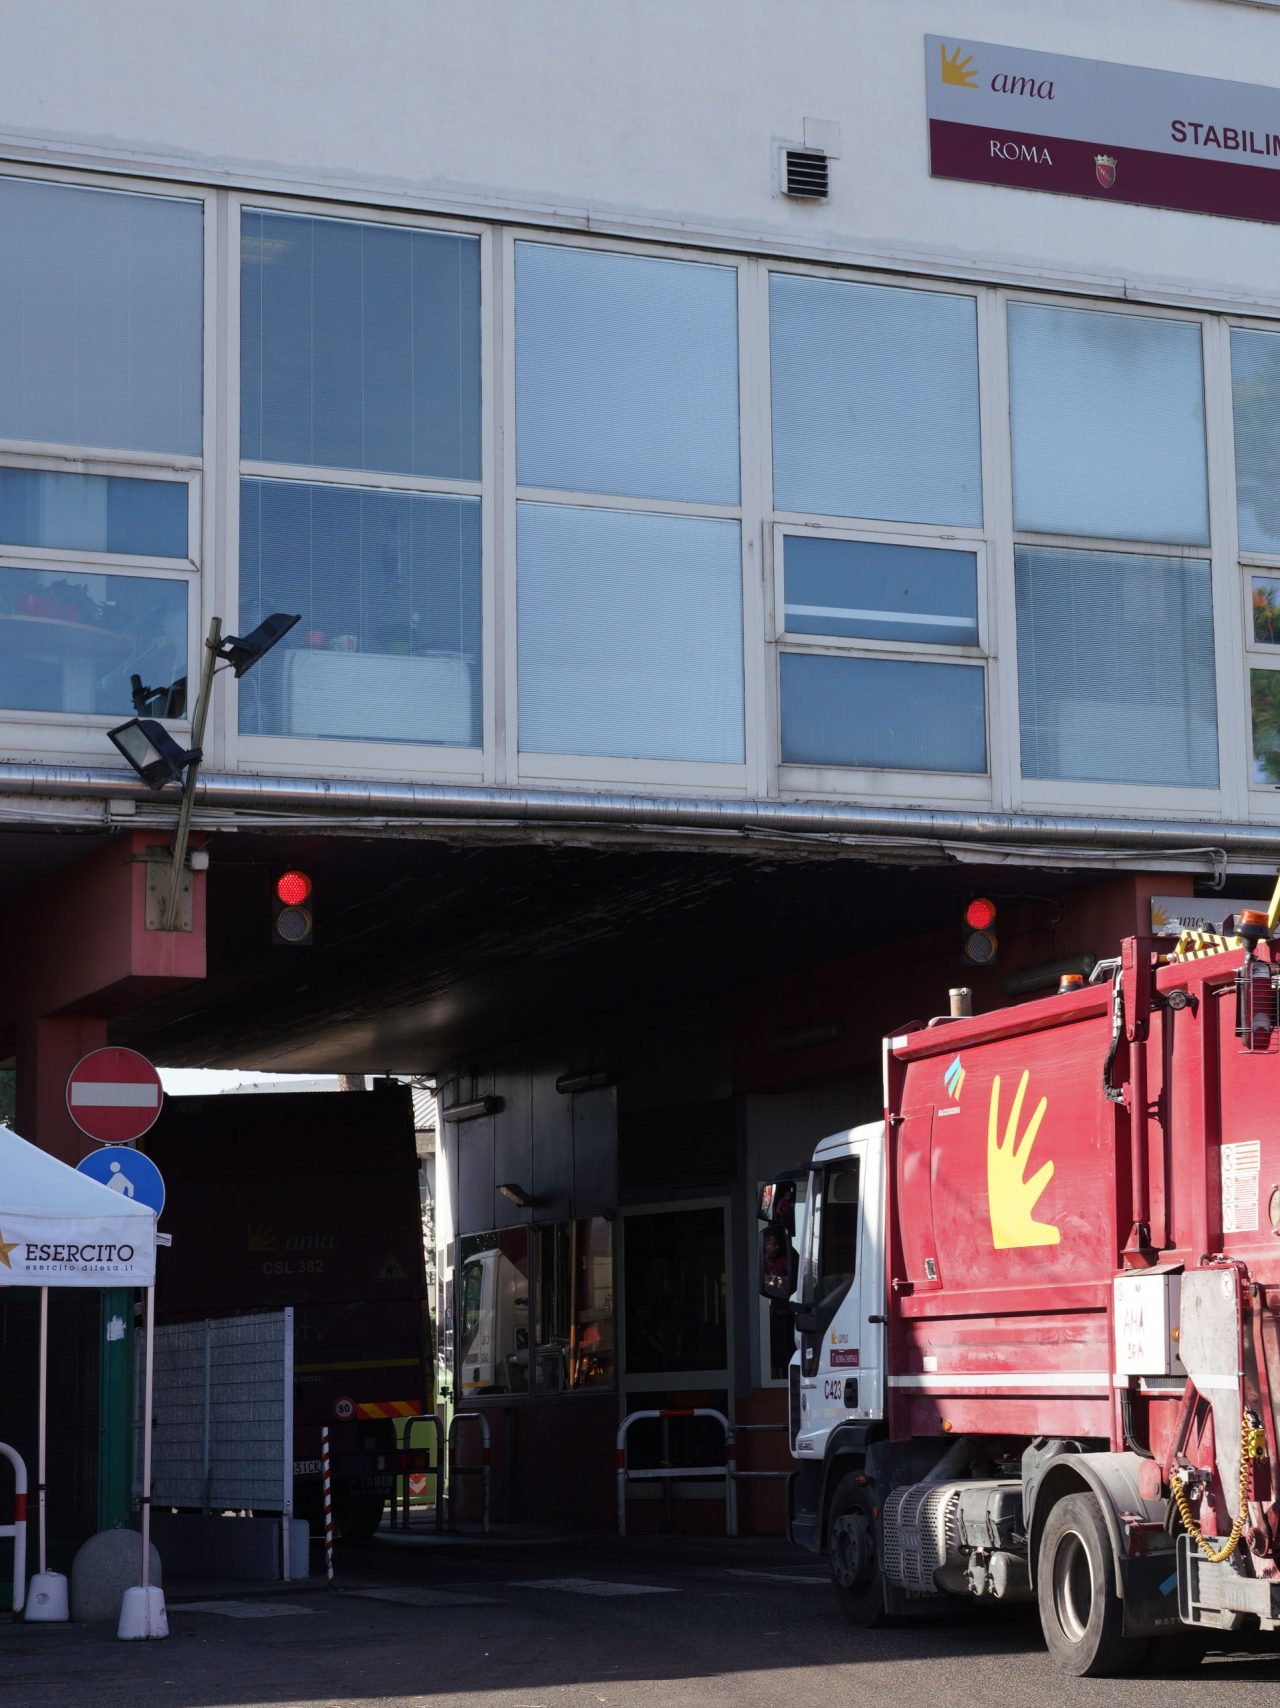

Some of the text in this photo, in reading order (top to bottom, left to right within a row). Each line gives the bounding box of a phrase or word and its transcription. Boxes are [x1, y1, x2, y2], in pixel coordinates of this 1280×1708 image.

[990, 73, 1055, 100] ama
[990, 140, 1053, 166] ROMA
[25, 1243, 135, 1263] ESERCITO
[25, 1263, 134, 1272] esercito.difesa.it
[262, 1260, 324, 1275] CSL 382
[824, 1380, 842, 1400] C423
[338, 1404, 350, 1414] 80
